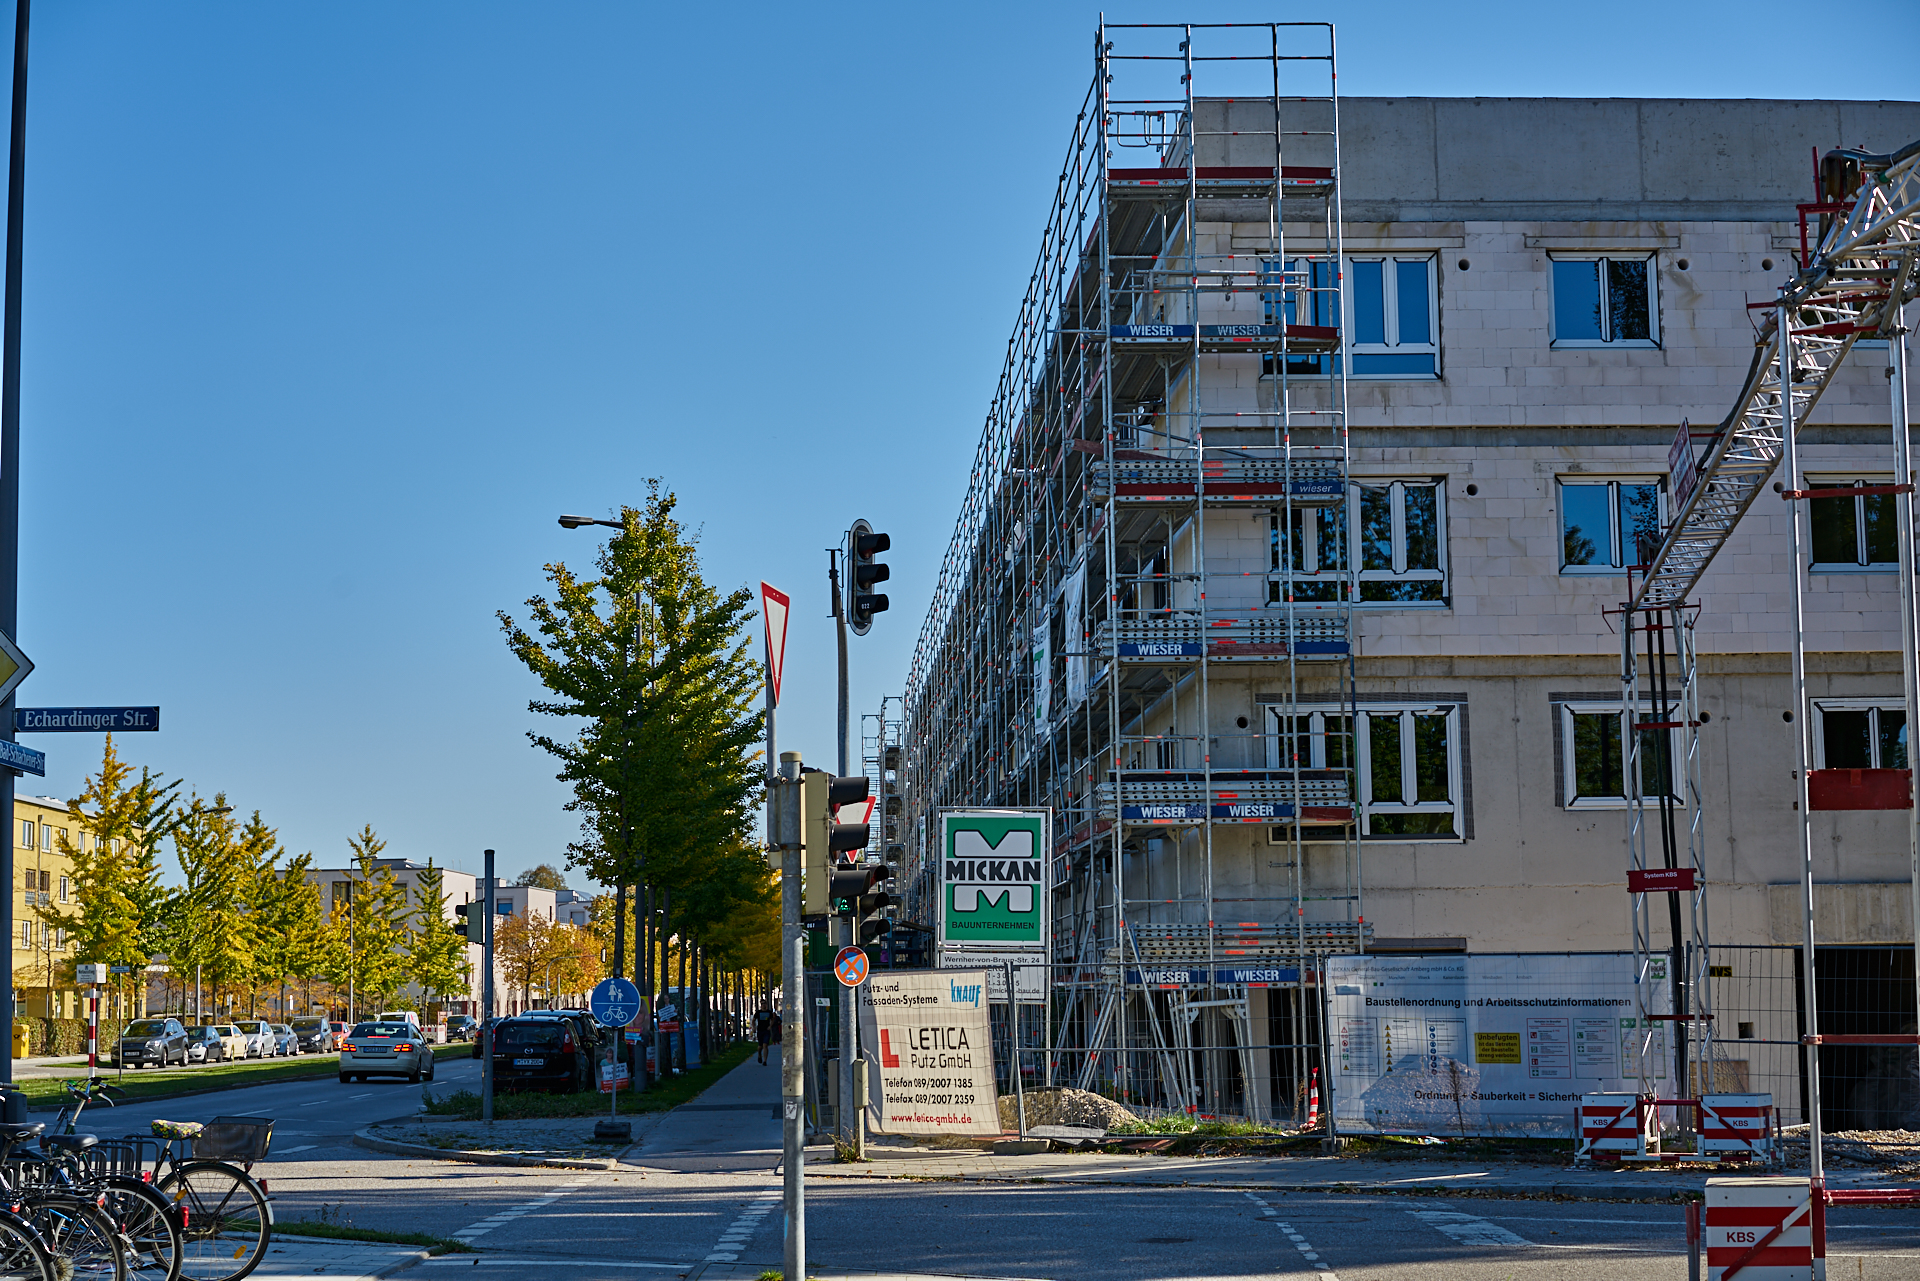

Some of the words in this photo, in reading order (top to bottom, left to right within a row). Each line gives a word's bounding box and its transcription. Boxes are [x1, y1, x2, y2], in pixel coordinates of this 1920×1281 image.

[1129, 326, 1174, 336] WIESER
[1217, 326, 1261, 336] WIESER
[1299, 483, 1332, 493] wieser
[1137, 644, 1183, 655] WIESER
[24, 710, 118, 730] Echardinger
[123, 709, 149, 726] Str.
[1141, 807, 1186, 818] WIESER
[1229, 805, 1274, 817] WIESER
[946, 860, 1041, 881] MICKAN
[1644, 872, 1664, 880] System
[1665, 871, 1678, 879] KBS
[951, 921, 1035, 930] BAUUNTERNEHMEN
[1031, 956, 1040, 964] 24
[1144, 972, 1189, 983] WIESER
[1234, 970, 1279, 981] WIESER
[863, 984, 883, 993] Putz-
[885, 982, 899, 992] und
[863, 995, 938, 1007] Fassaden-Systeme
[1365, 998, 1460, 1008] Baustellenordnung
[1464, 998, 1483, 1006] und
[1486, 998, 1631, 1007] Arbeitsschutzinformationen
[909, 1027, 969, 1050] LETICA
[1477, 1033, 1517, 1041] Unbefugten
[910, 1053, 936, 1068] Putz
[939, 1053, 971, 1068] GmbH
[885, 1077, 913, 1088] Telefon
[953, 1078, 972, 1088] 1385
[886, 1093, 913, 1103] Telefax
[954, 1094, 975, 1104] 2359
[1471, 1092, 1526, 1101] Sauberkeit
[1726, 1231, 1755, 1243] KBS
